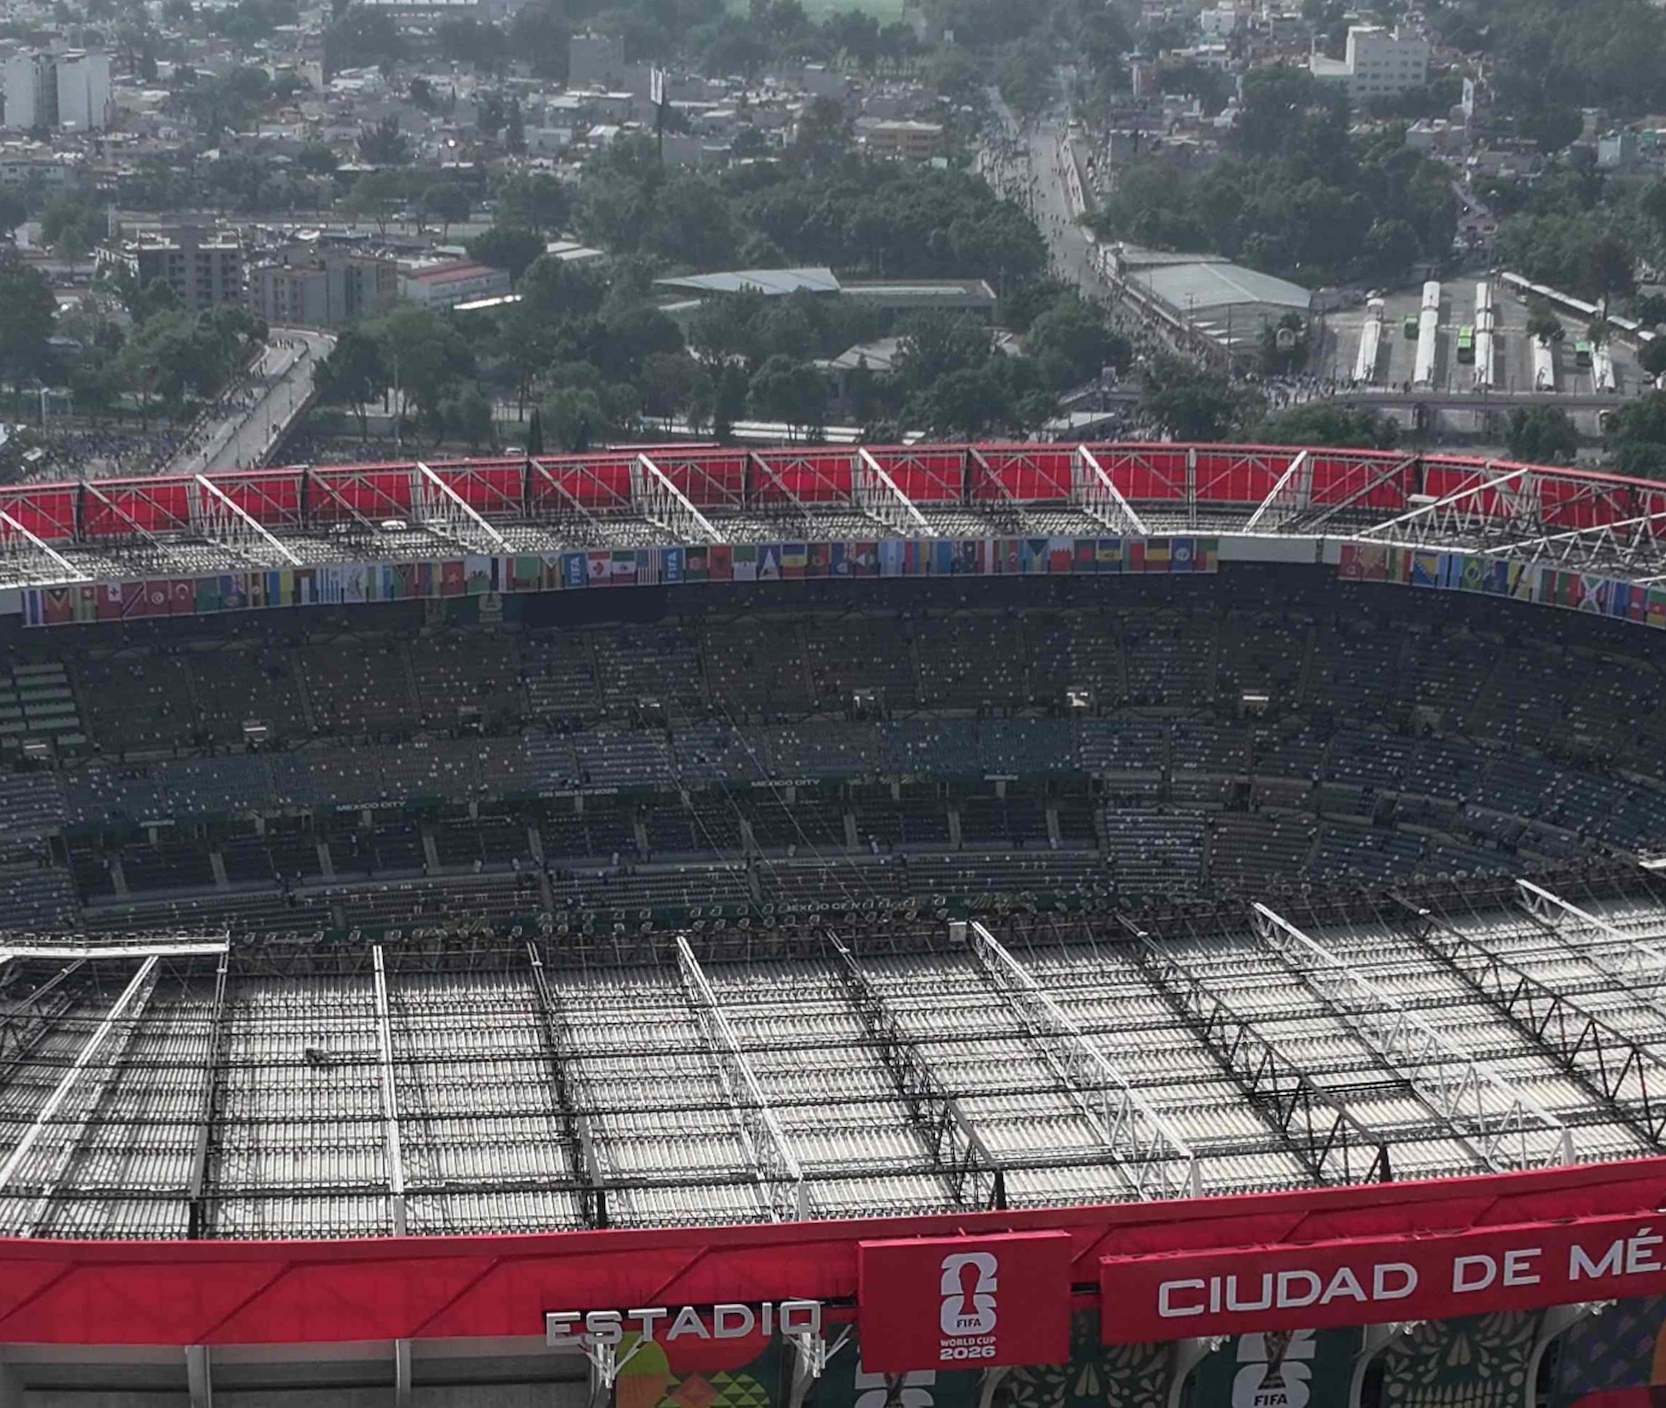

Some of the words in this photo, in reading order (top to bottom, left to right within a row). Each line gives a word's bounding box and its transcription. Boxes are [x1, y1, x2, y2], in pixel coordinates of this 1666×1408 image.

[335, 802, 377, 812] MEXICO
[379, 800, 407, 810] CITY
[1157, 1262, 1418, 1318] CIUDAD
[1451, 1247, 1543, 1294] DE
[545, 1300, 822, 1346] ESTADIO
[956, 1318, 982, 1328] FIFA
[940, 1338, 975, 1347] WORLD
[976, 1336, 997, 1345] CUP
[939, 1346, 997, 1361] 2026
[1253, 1393, 1288, 1407] FIFA
